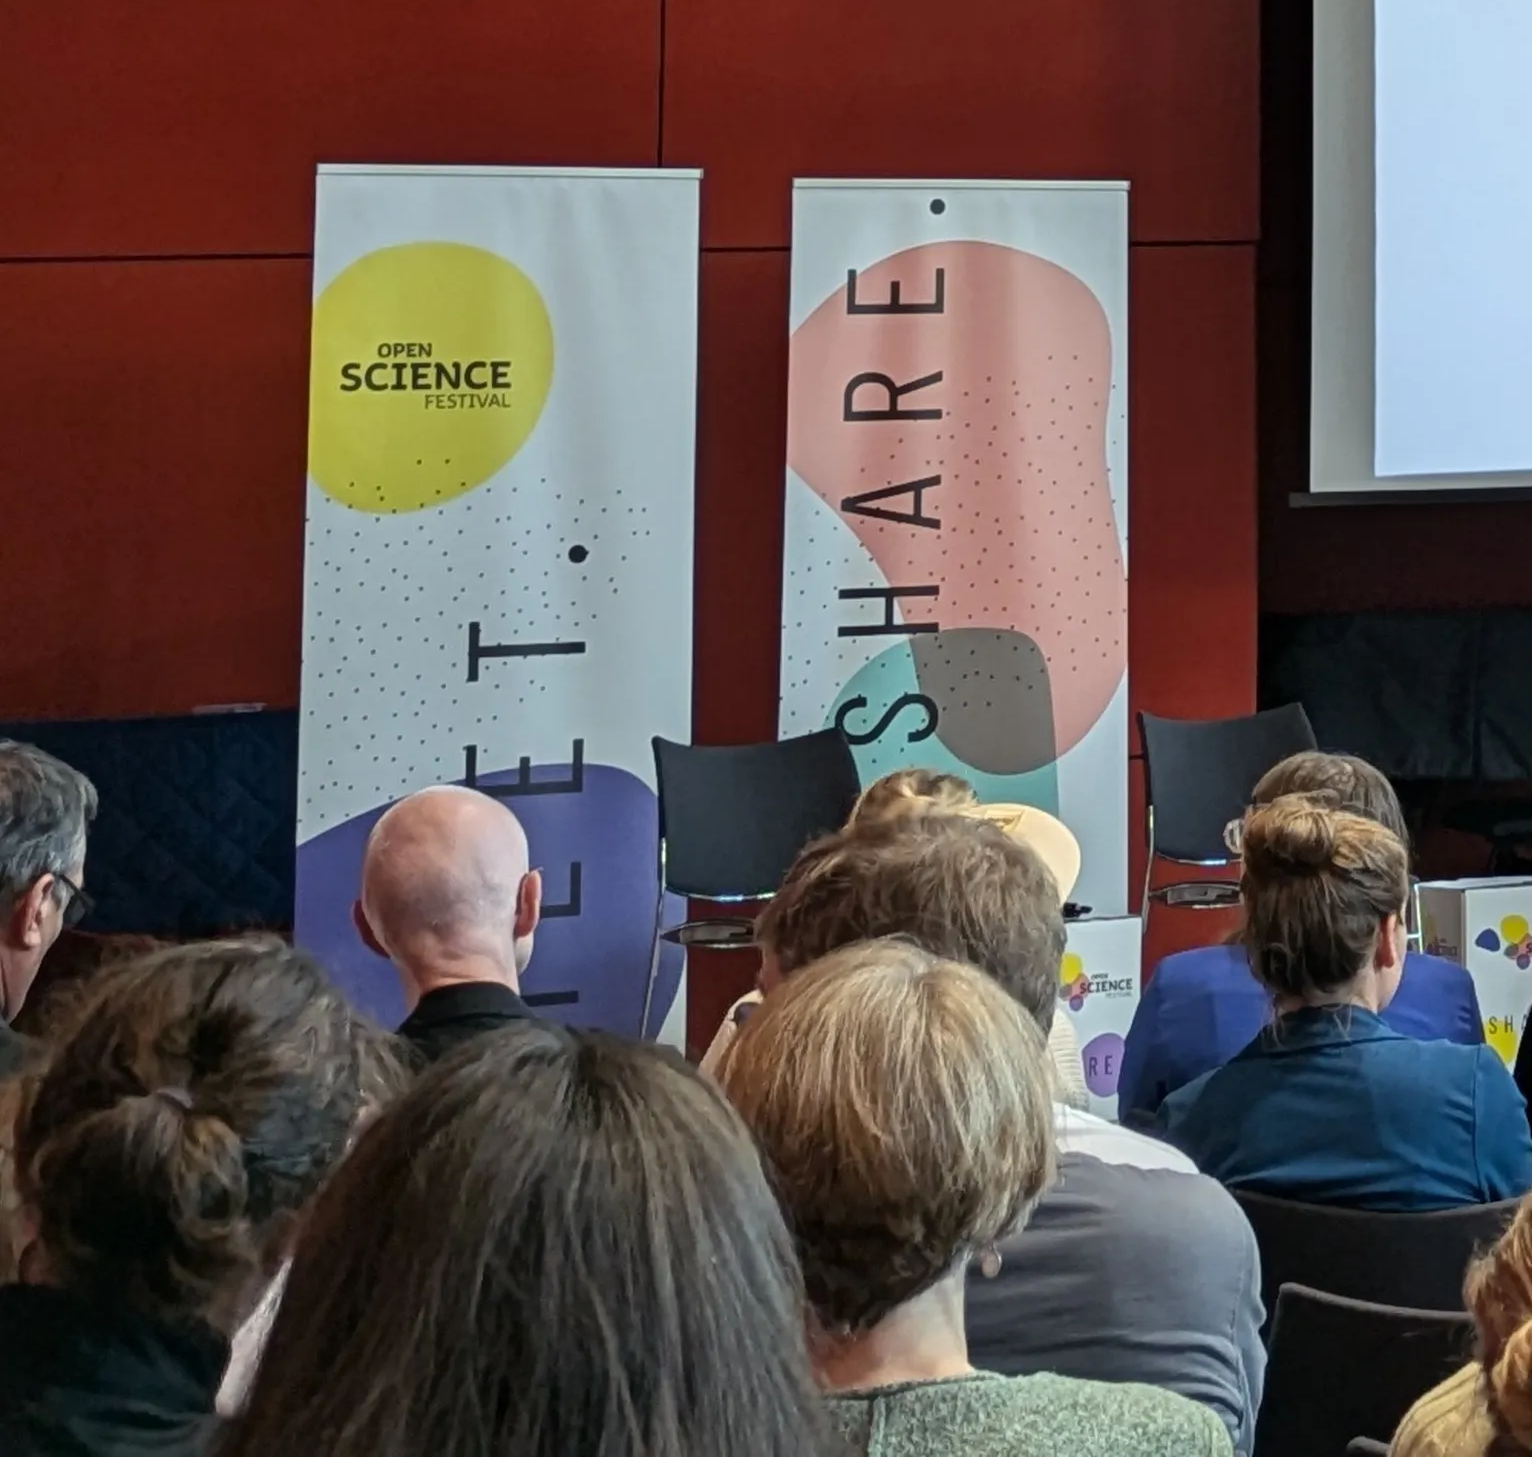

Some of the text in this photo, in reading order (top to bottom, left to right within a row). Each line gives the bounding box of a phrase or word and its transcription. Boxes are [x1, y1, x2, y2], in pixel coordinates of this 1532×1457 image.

[377, 342, 433, 359] OPEN
[339, 360, 513, 393] SCIENCE
[424, 393, 512, 410] FESTIVAL
[1079, 978, 1133, 995] SCIENCE
